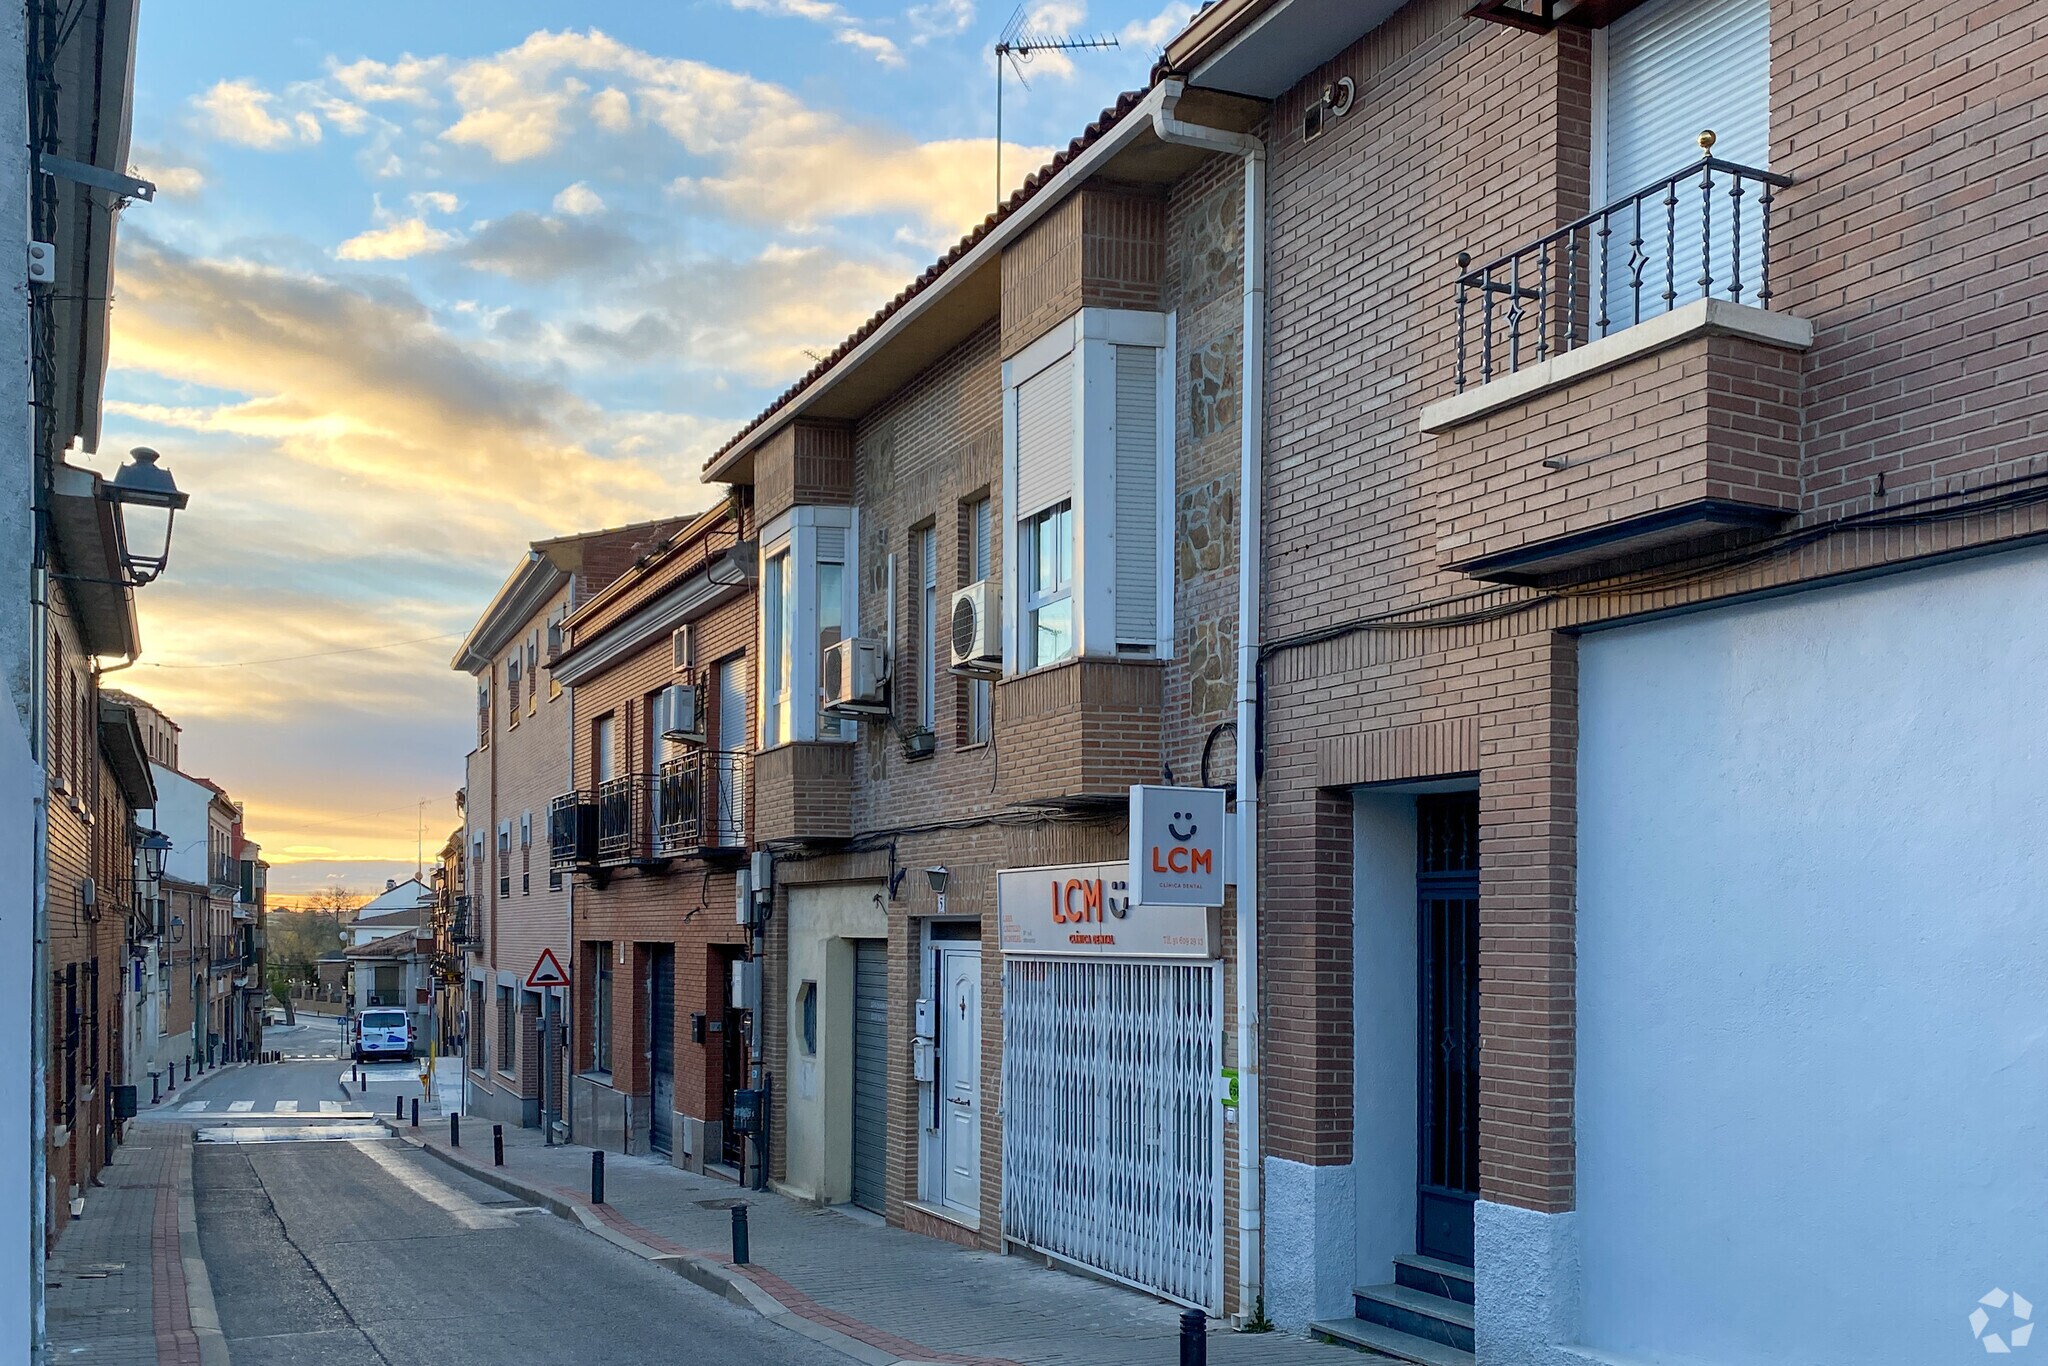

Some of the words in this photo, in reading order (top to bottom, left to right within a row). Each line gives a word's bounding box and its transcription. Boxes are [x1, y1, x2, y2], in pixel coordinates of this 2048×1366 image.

[1152, 846, 1212, 874] LCM
[1051, 878, 1103, 924] LCM
[1093, 934, 1115, 945] DENTAL
